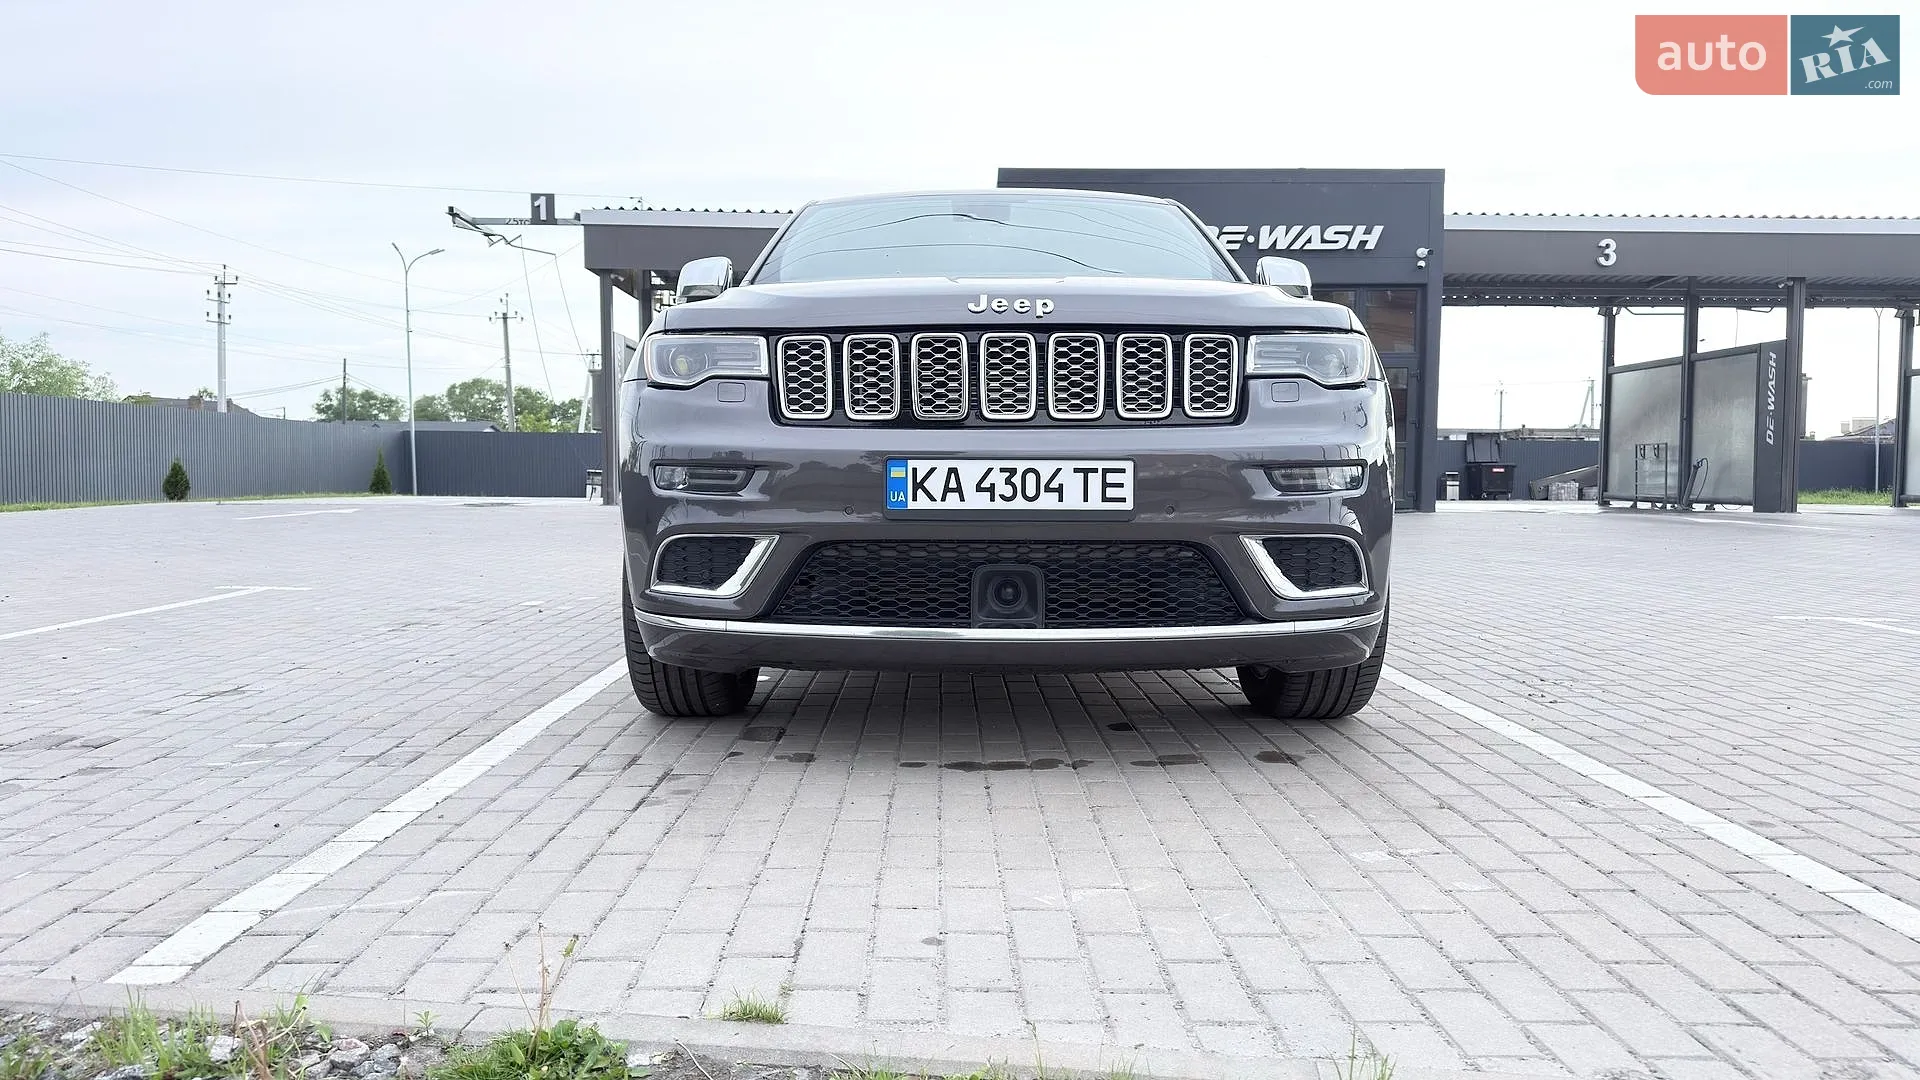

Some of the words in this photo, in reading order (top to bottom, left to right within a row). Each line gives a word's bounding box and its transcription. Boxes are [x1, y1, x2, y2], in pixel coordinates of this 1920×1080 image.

[533, 195, 548, 221] 1
[1597, 238, 1617, 266] 3
[967, 294, 1055, 319] Jeep
[890, 490, 906, 502] UA
[911, 466, 966, 503] KA
[975, 467, 1064, 503] 4304
[1073, 467, 1127, 503] TE
